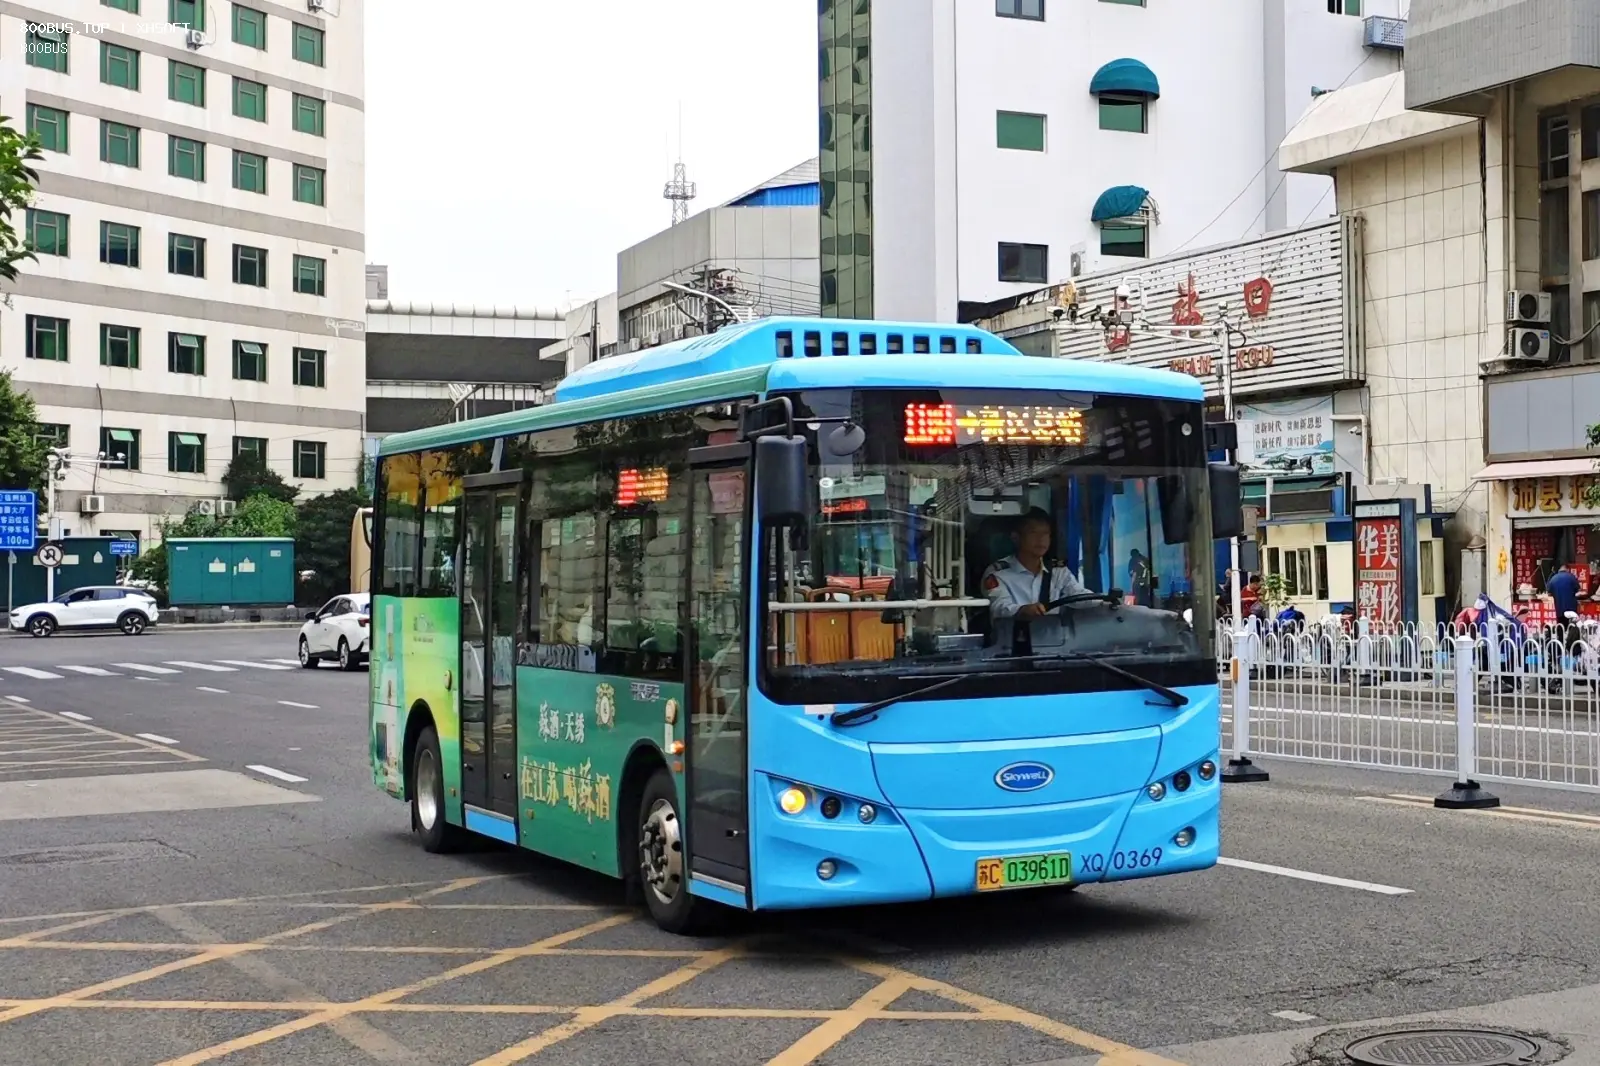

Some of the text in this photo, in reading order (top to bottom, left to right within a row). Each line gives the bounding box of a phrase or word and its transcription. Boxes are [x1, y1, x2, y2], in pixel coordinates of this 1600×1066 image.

[1235, 345, 1274, 371] KOU
[1358, 524, 1398, 568] 华美
[1080, 846, 1164, 874] XQ 0369
